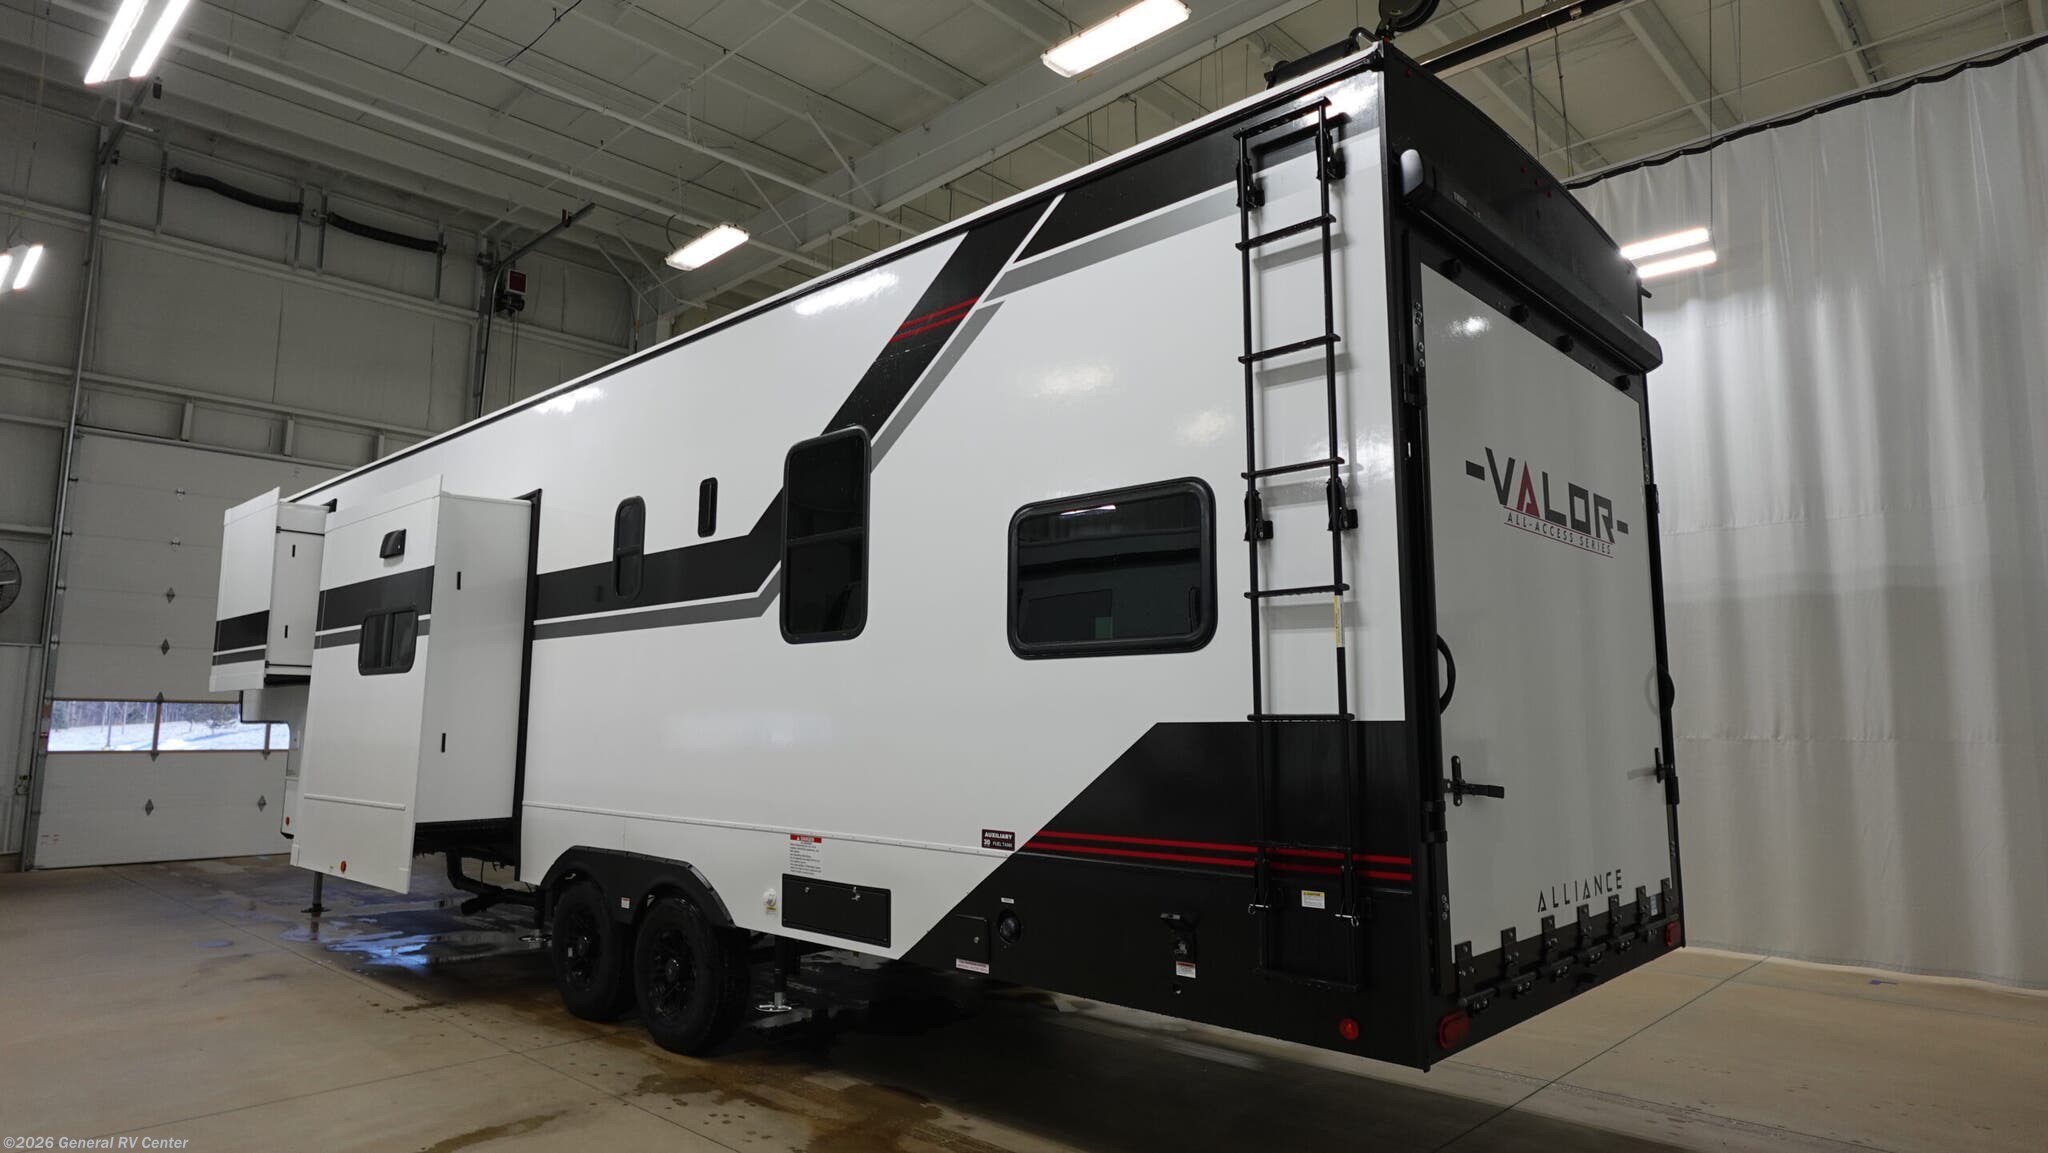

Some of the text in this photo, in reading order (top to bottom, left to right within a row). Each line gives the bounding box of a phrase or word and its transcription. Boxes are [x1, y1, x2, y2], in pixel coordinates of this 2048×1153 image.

[1507, 512, 1611, 555] ALL-ACCESS SERIES
[984, 831, 1013, 840] AUXILIARY
[1537, 868, 1622, 913] ALLIANCE
